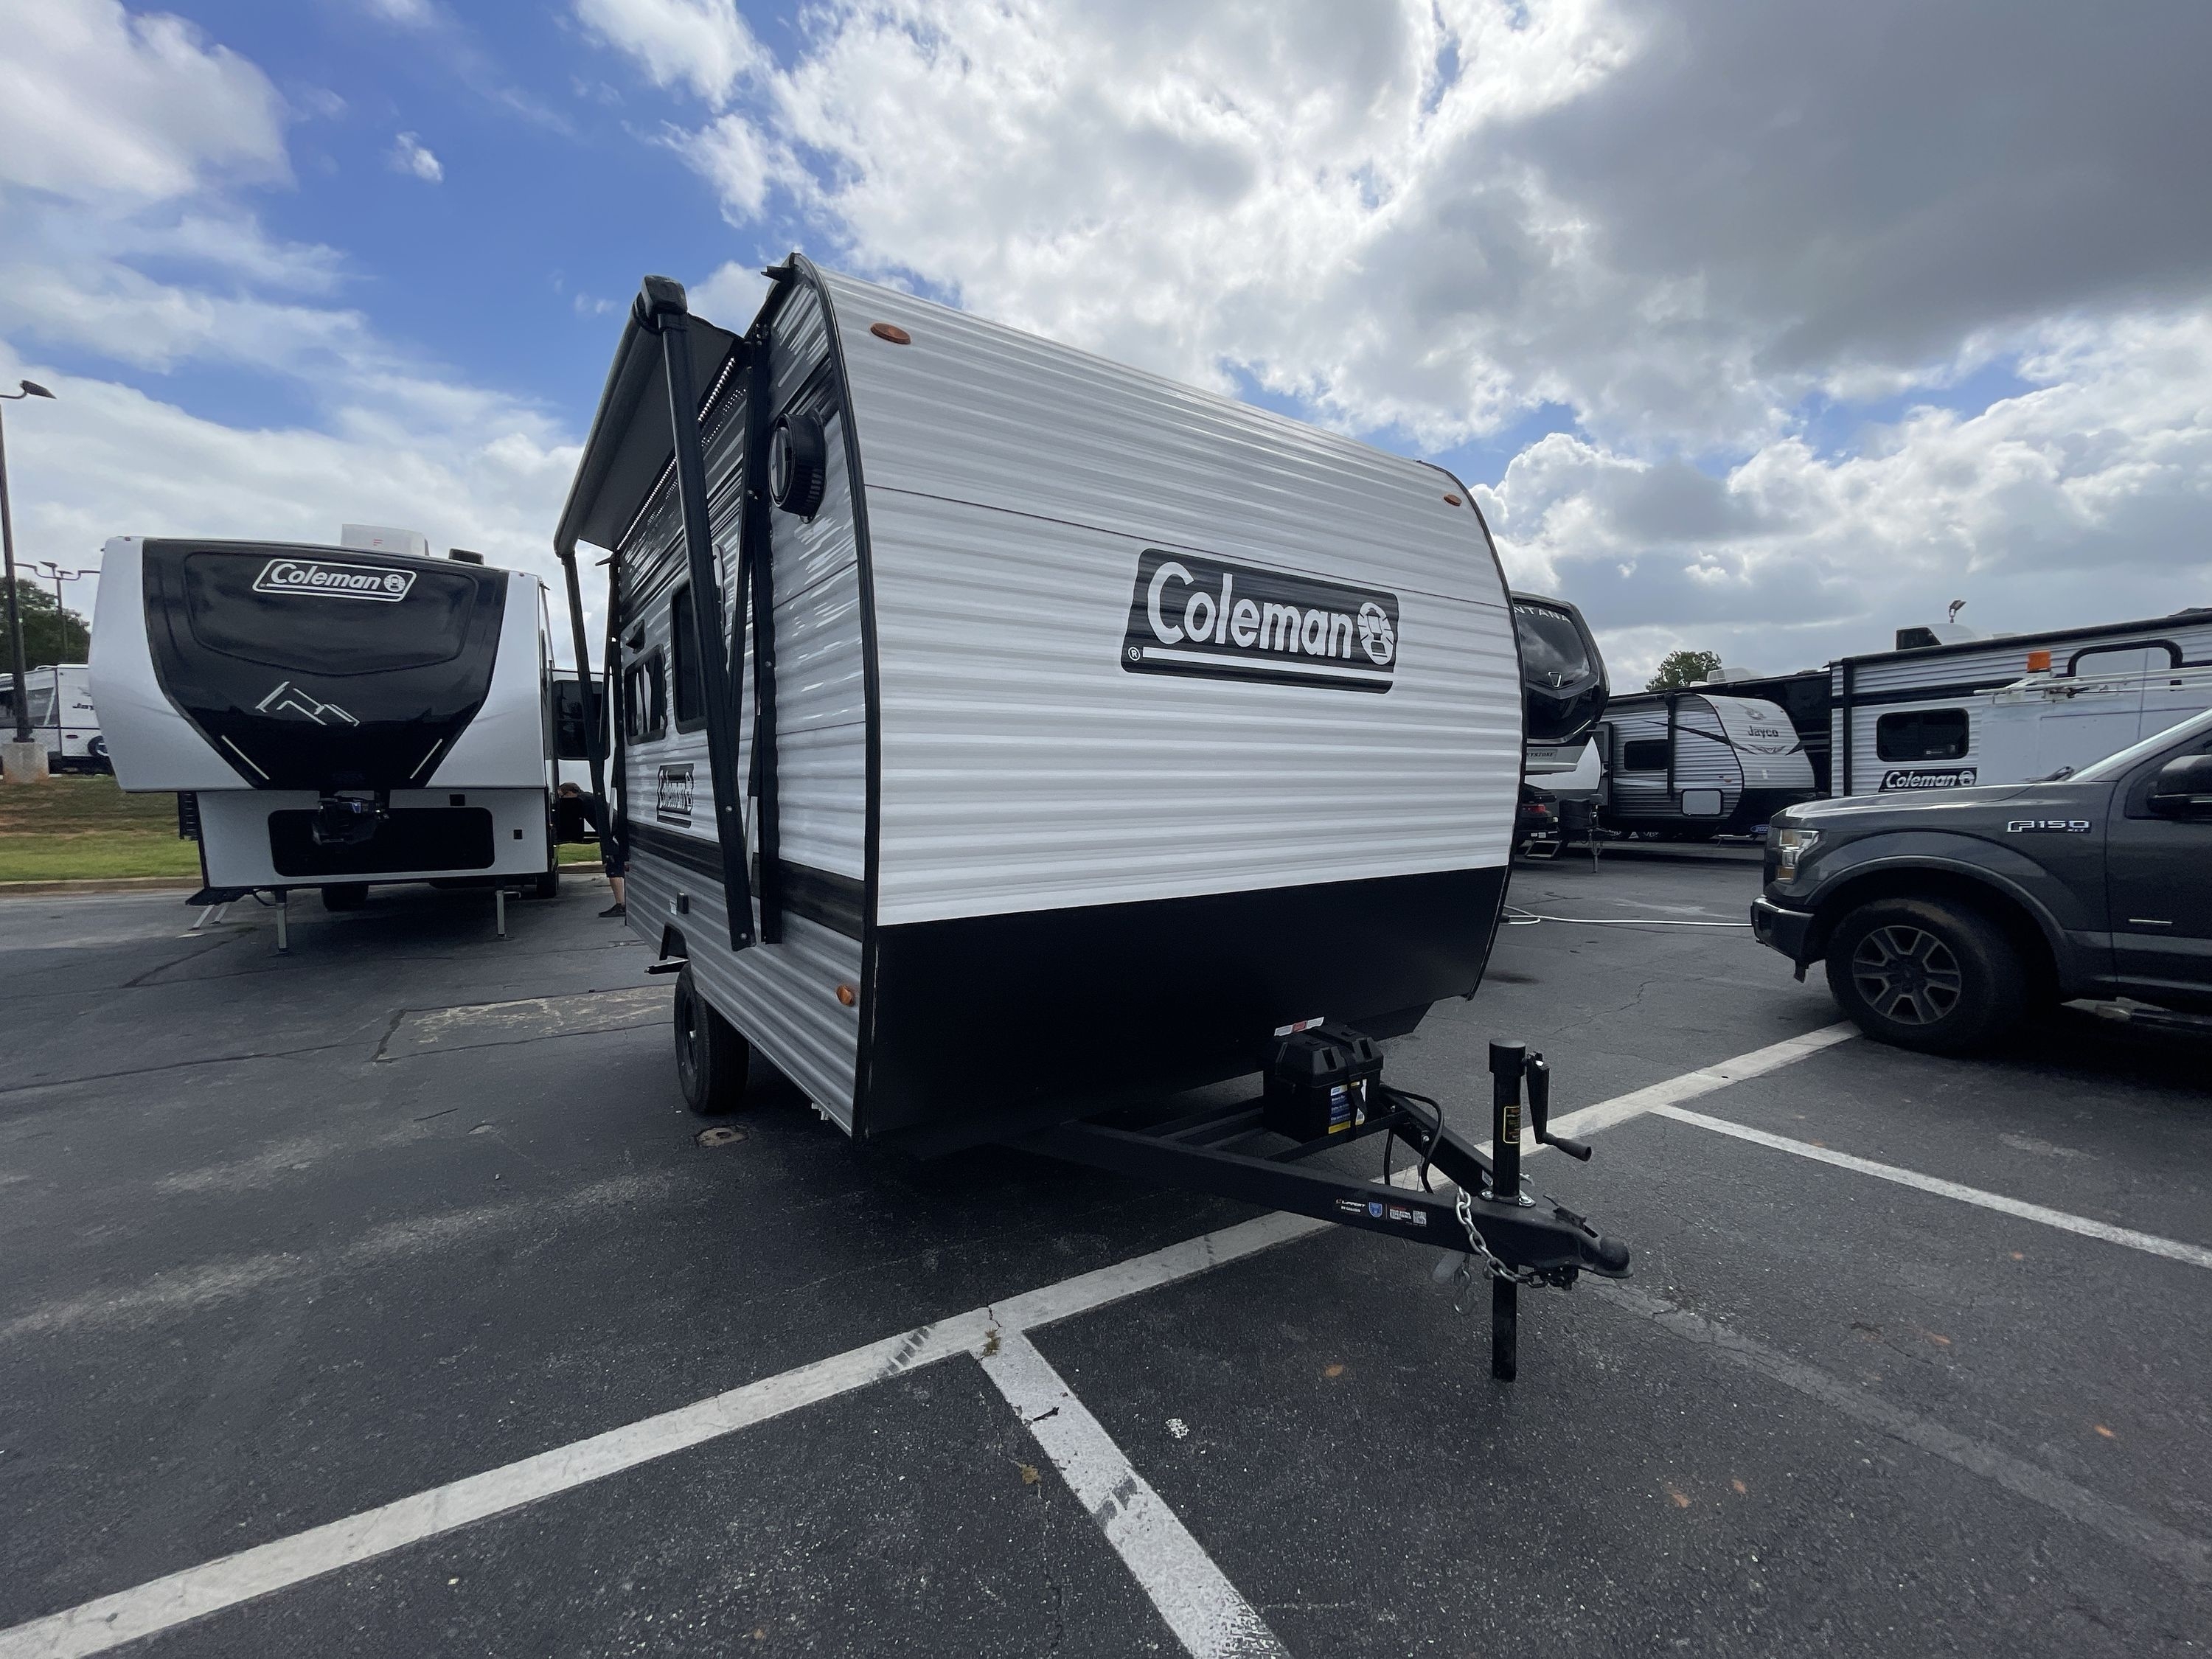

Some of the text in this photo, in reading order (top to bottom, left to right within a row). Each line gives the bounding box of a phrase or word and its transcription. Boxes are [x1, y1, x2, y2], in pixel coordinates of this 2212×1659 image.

[271, 563, 382, 590] Coleman
[1147, 561, 1354, 658] Coleman
[1514, 606, 1571, 623] NTANA
[1748, 726, 1779, 738] Jayco
[1886, 771, 1958, 788] Coleman
